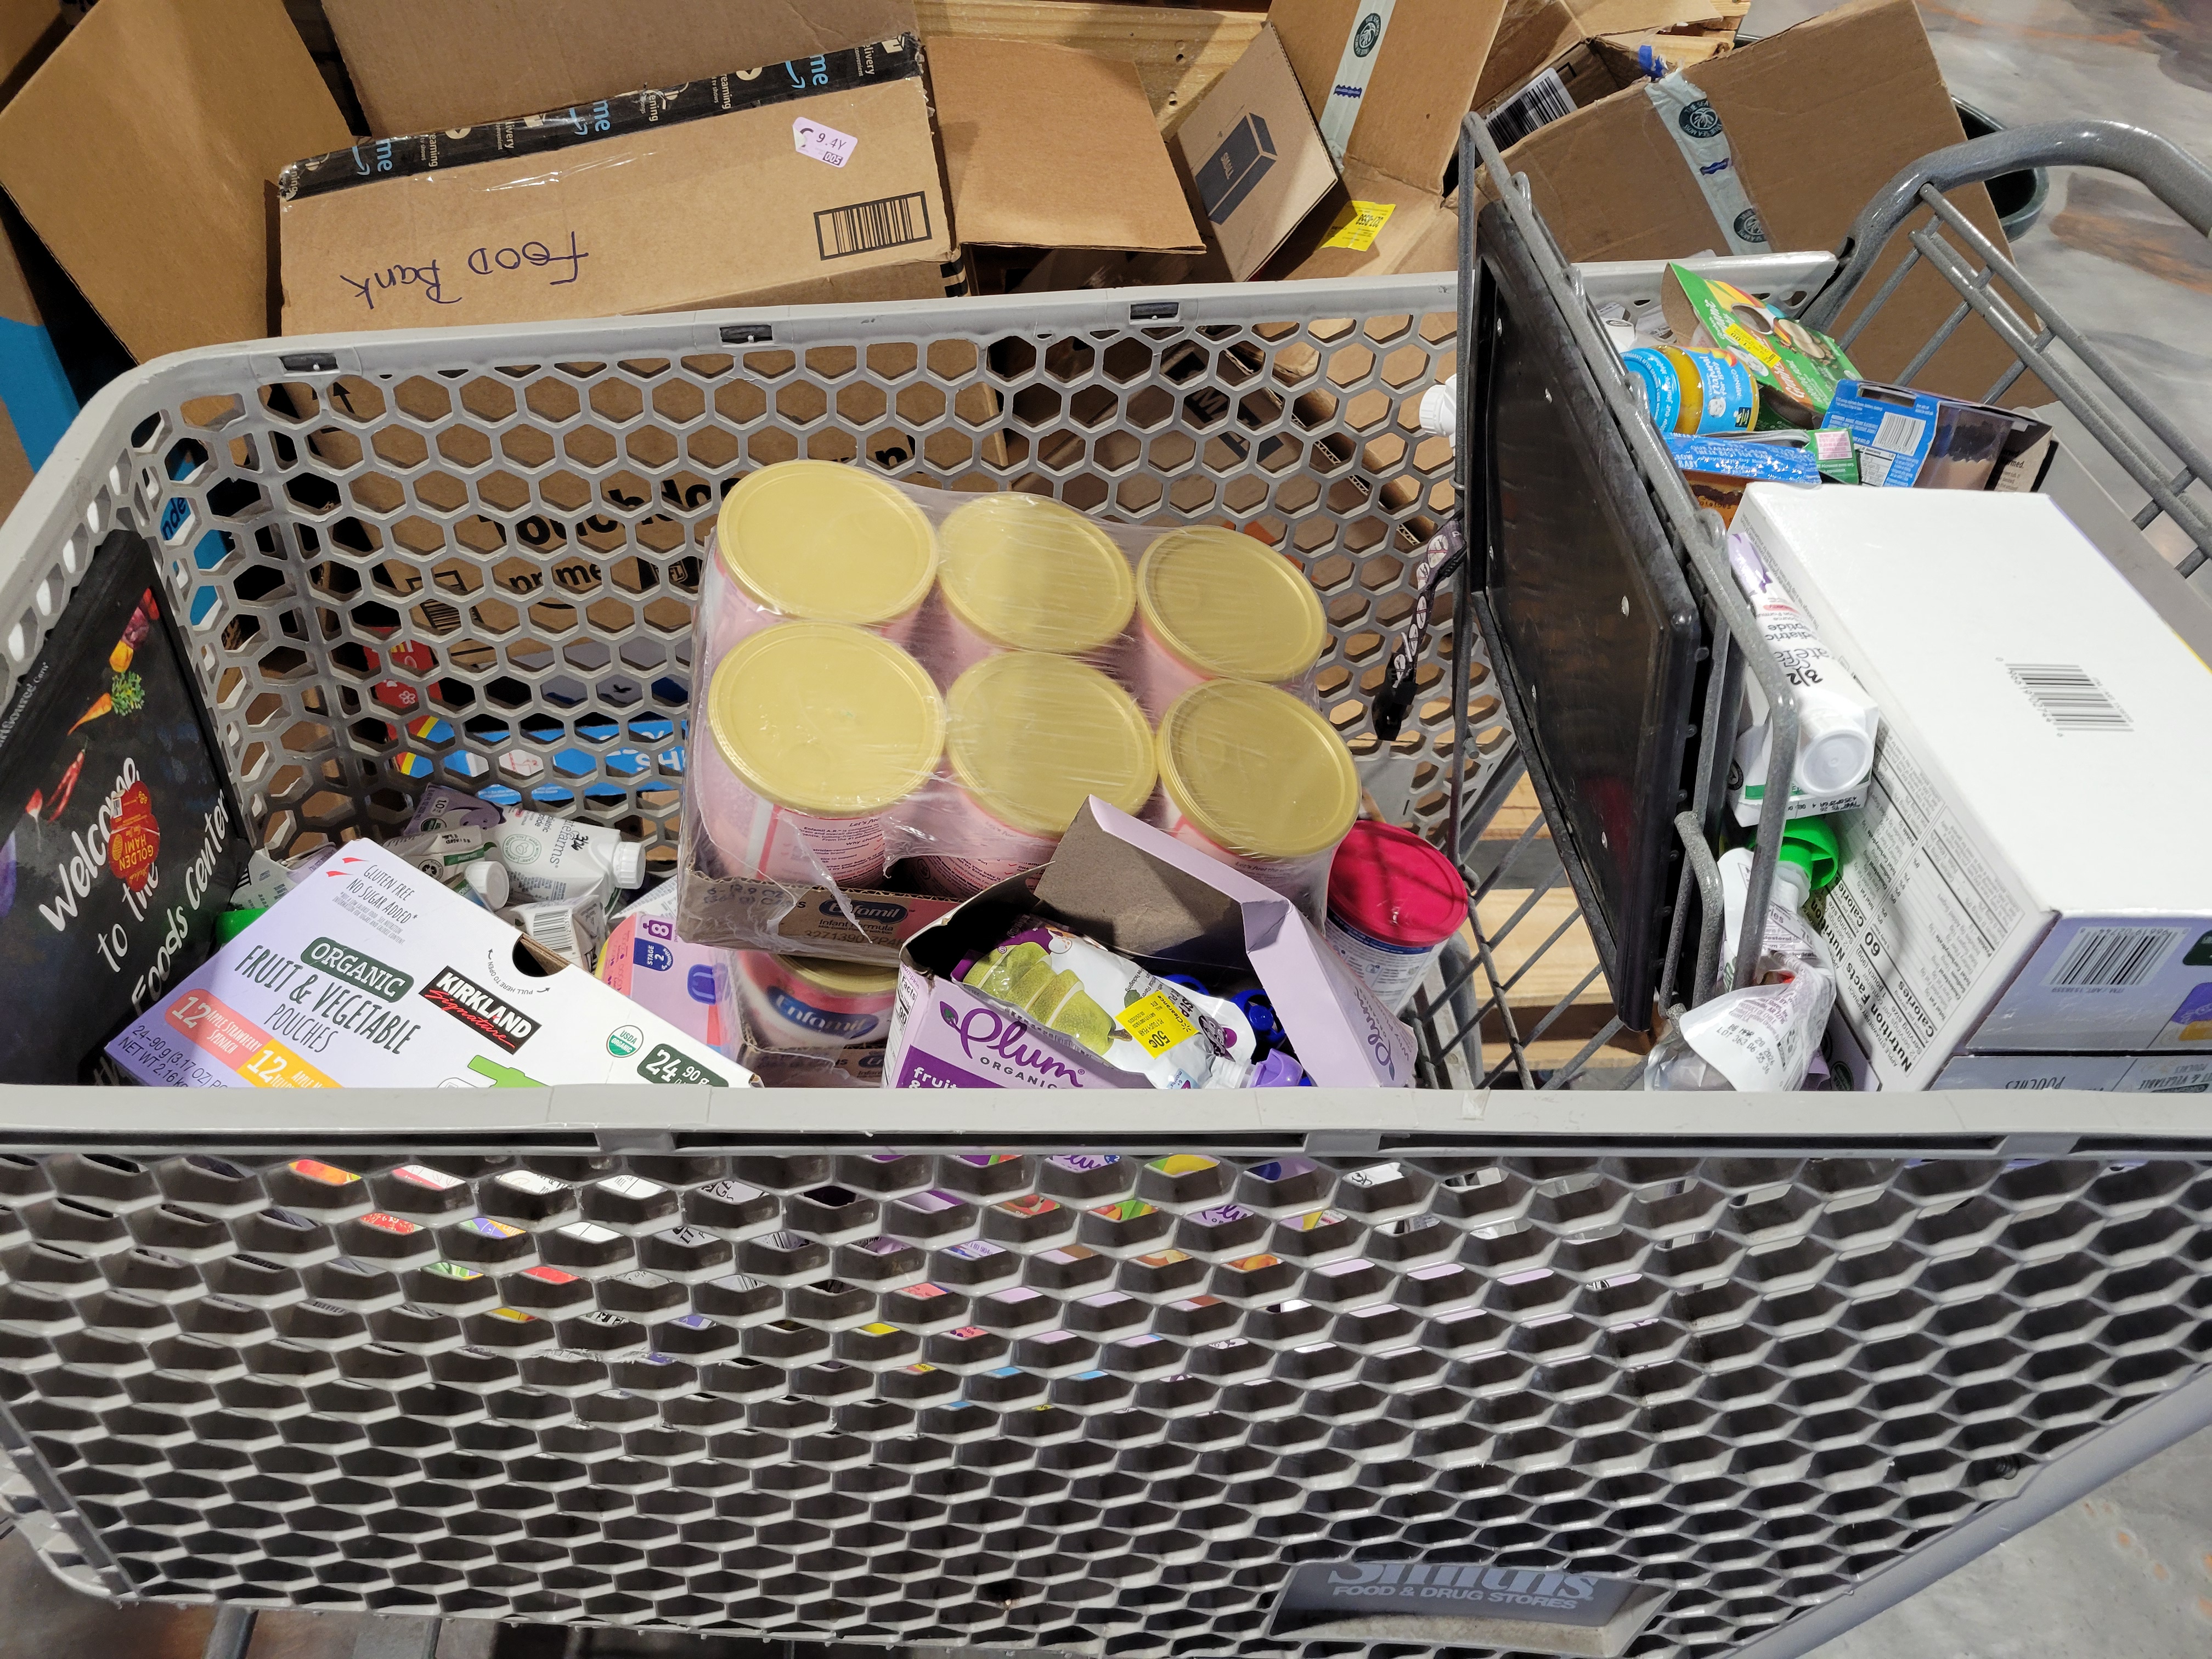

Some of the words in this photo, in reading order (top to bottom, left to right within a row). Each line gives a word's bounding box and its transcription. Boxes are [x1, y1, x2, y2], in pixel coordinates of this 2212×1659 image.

[824, 151, 842, 165] 005
[1220, 151, 1234, 180] SMALL
[340, 261, 462, 309] Bank
[1731, 369, 1742, 399] MANGO
[122, 833, 148, 852] HAMI
[862, 834, 882, 842] choose
[118, 844, 154, 872] GOLDEN
[364, 865, 397, 890] GLUTEN
[392, 883, 415, 901] FREE
[953, 866, 984, 889] Instructions
[131, 904, 190, 1017] Foods
[185, 788, 230, 912] Center
[346, 878, 364, 893] NO
[358, 886, 388, 909] SUGAR
[1826, 899, 1838, 917] size
[1831, 874, 1866, 929] Calories
[332, 896, 357, 915] INFORMATION
[358, 911, 371, 923] SUGARS
[376, 923, 391, 935] CALORIE
[356, 902, 371, 914] CALORIE
[383, 919, 403, 934] NUTRITION
[651, 923, 669, 936] 8
[819, 919, 848, 928] Infant
[1826, 911, 1846, 940] servings
[1835, 913, 1855, 945] Serving
[1846, 912, 1860, 934] Amount
[1806, 899, 1848, 962] Nutrition
[1863, 929, 1882, 958] 60
[97, 923, 129, 973] to
[663, 948, 673, 966] months
[1854, 946, 1870, 969] (90g)
[309, 941, 407, 997] ORGANIC
[1842, 960, 1872, 1005] Facts
[1866, 965, 1884, 993] pouch
[234, 944, 303, 993] FRUIT
[291, 975, 313, 1005] &
[312, 981, 421, 1056] VEGETABLE
[902, 976, 916, 1000] Facts
[1847, 985, 1864, 1011] SPINACH
[1861, 972, 1884, 1006] container
[1893, 988, 1909, 1012] serving
[425, 989, 516, 1048] Signature
[435, 973, 534, 1040] KIRKLAND
[775, 995, 866, 1032] Enfamil
[899, 1006, 907, 1024] 90
[1157, 995, 1183, 1024] Clearance
[1882, 1003, 1892, 1019] per
[1890, 1005, 1902, 1023] size
[1895, 978, 1936, 1040] Calories
[172, 996, 212, 1029] 12
[205, 1009, 228, 1030] APPLE
[225, 1021, 263, 1052] STRAWBERRY
[263, 1002, 339, 1054] POUCHES
[619, 1030, 637, 1045] USDA
[1870, 1002, 1913, 1073] Nutrition
[1889, 1016, 1912, 1051] servings
[1900, 1021, 1923, 1055] Serving
[1912, 1019, 1929, 1045] Amount
[207, 1029, 239, 1054] SPINACH
[611, 1037, 633, 1053] ORGANIC
[959, 1008, 1084, 1088] Plum
[1147, 1030, 1173, 1049] 50¢
[118, 1036, 141, 1058] NET
[137, 1047, 155, 1066] WT
[153, 1062, 178, 1083] 2.16
[169, 1051, 191, 1072] (3.17
[192, 1067, 213, 1087] OZ)
[246, 1049, 287, 1084] 12
[646, 1049, 681, 1082] 24
[682, 1066, 701, 1081] 90
[1887, 1049, 1898, 1068] APPLE
[1910, 1049, 1917, 1061] 12
[1333, 1585, 1396, 1596] FOOD
[1400, 1587, 1416, 1597] &
[1424, 1587, 1483, 1601] DRUG
[1487, 1592, 1579, 1610] STORES
